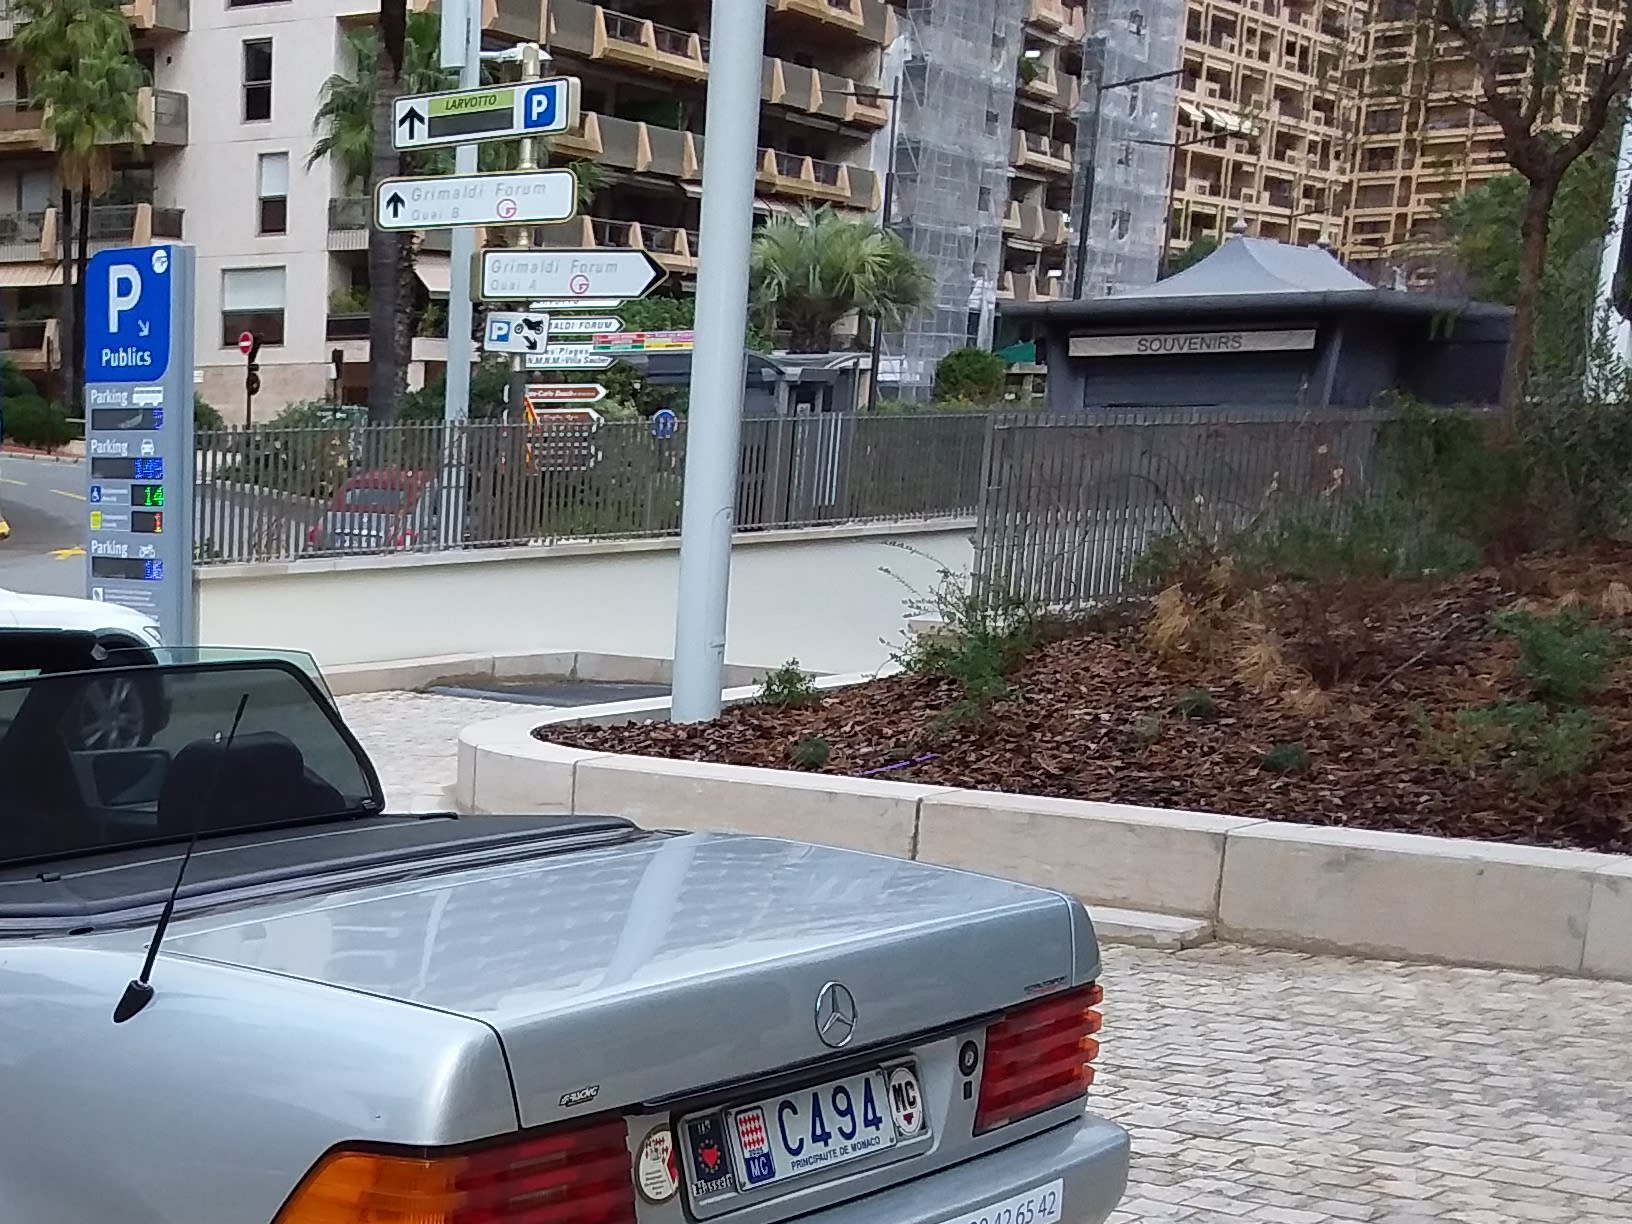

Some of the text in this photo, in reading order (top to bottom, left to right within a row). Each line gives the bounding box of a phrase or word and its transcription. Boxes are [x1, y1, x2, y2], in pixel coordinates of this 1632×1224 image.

[445, 94, 497, 111] LARVOTTO
[531, 94, 549, 121] P
[411, 183, 547, 202] Grimaldi Forum
[411, 209, 443, 221] Quai
[490, 259, 618, 274] Grimaldi Forum
[490, 280, 520, 291] Quai
[108, 264, 141, 333] P
[579, 321, 612, 329] FORUM
[1137, 335, 1243, 352] SOUVENIRS
[101, 347, 152, 367] Publics
[90, 389, 128, 407] Parking
[90, 439, 128, 457] Parking
[144, 486, 164, 506] 14
[91, 540, 128, 558] Parking
[892, 1080, 917, 1113] MC
[777, 1077, 883, 1157] C494
[791, 1135, 881, 1171] PRINCIPAUTE DE MONACO
[749, 1158, 768, 1178] MC
[1037, 1190, 1056, 1218] 42
